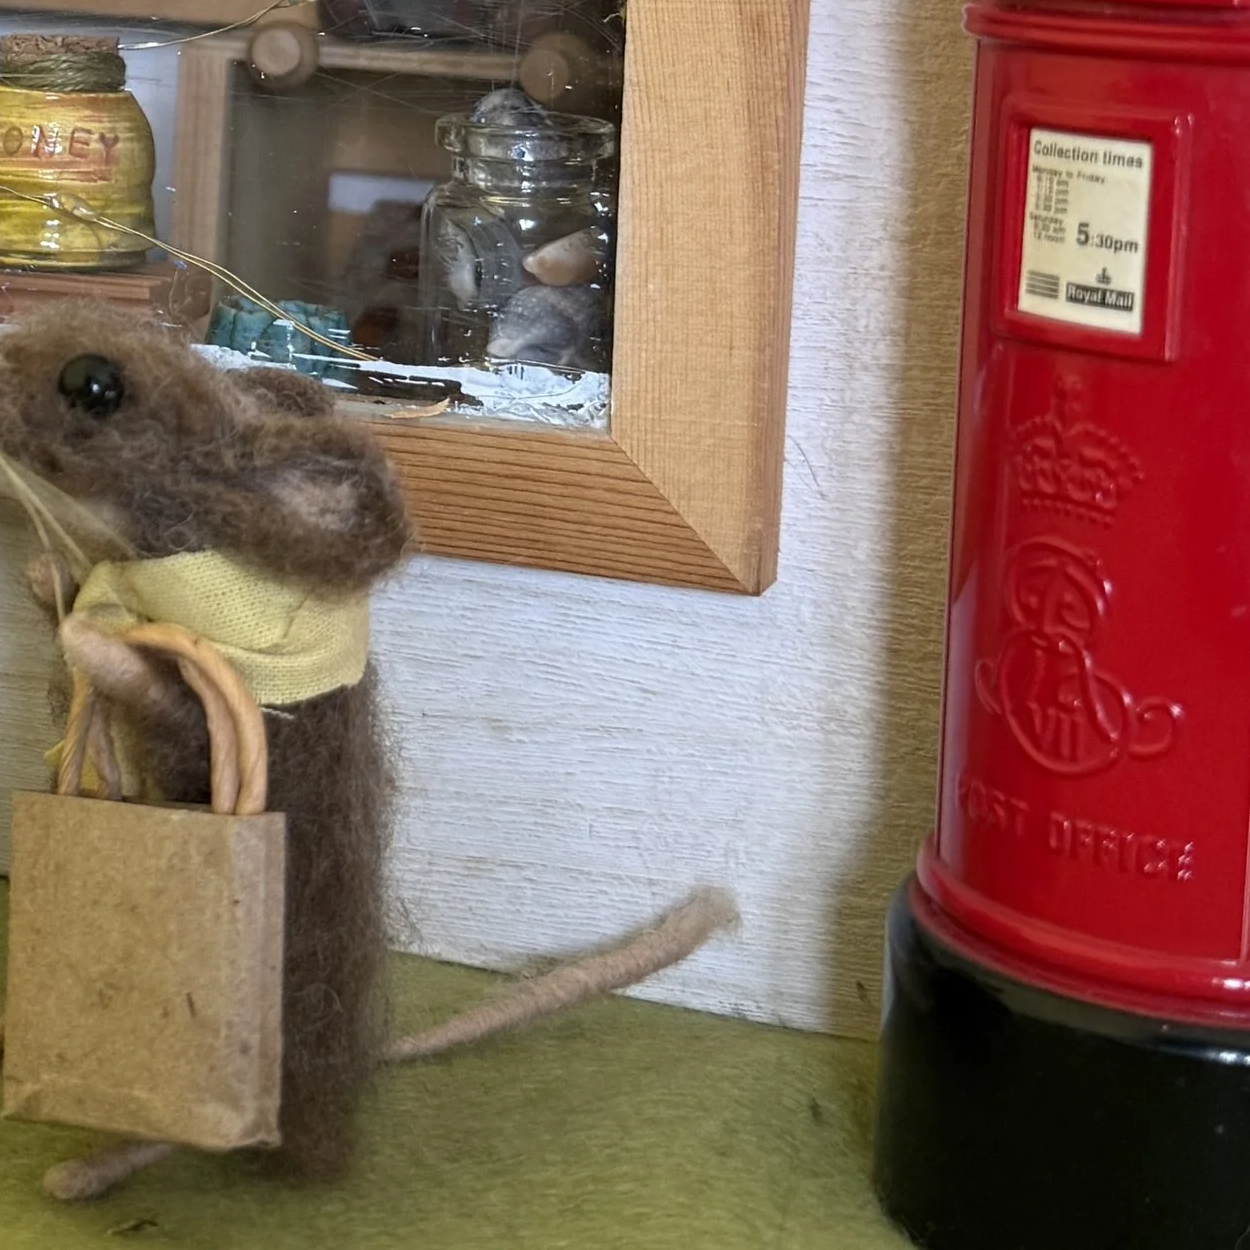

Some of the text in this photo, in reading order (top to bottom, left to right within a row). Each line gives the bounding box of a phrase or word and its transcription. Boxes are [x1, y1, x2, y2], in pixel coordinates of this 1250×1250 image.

[1033, 140, 1144, 168] Collection times
[1076, 171, 1105, 185] Friday
[1076, 222, 1138, 254] 5:30pm
[1066, 284, 1133, 308] Royal Mail
[1049, 810, 1196, 883] OFFICE
